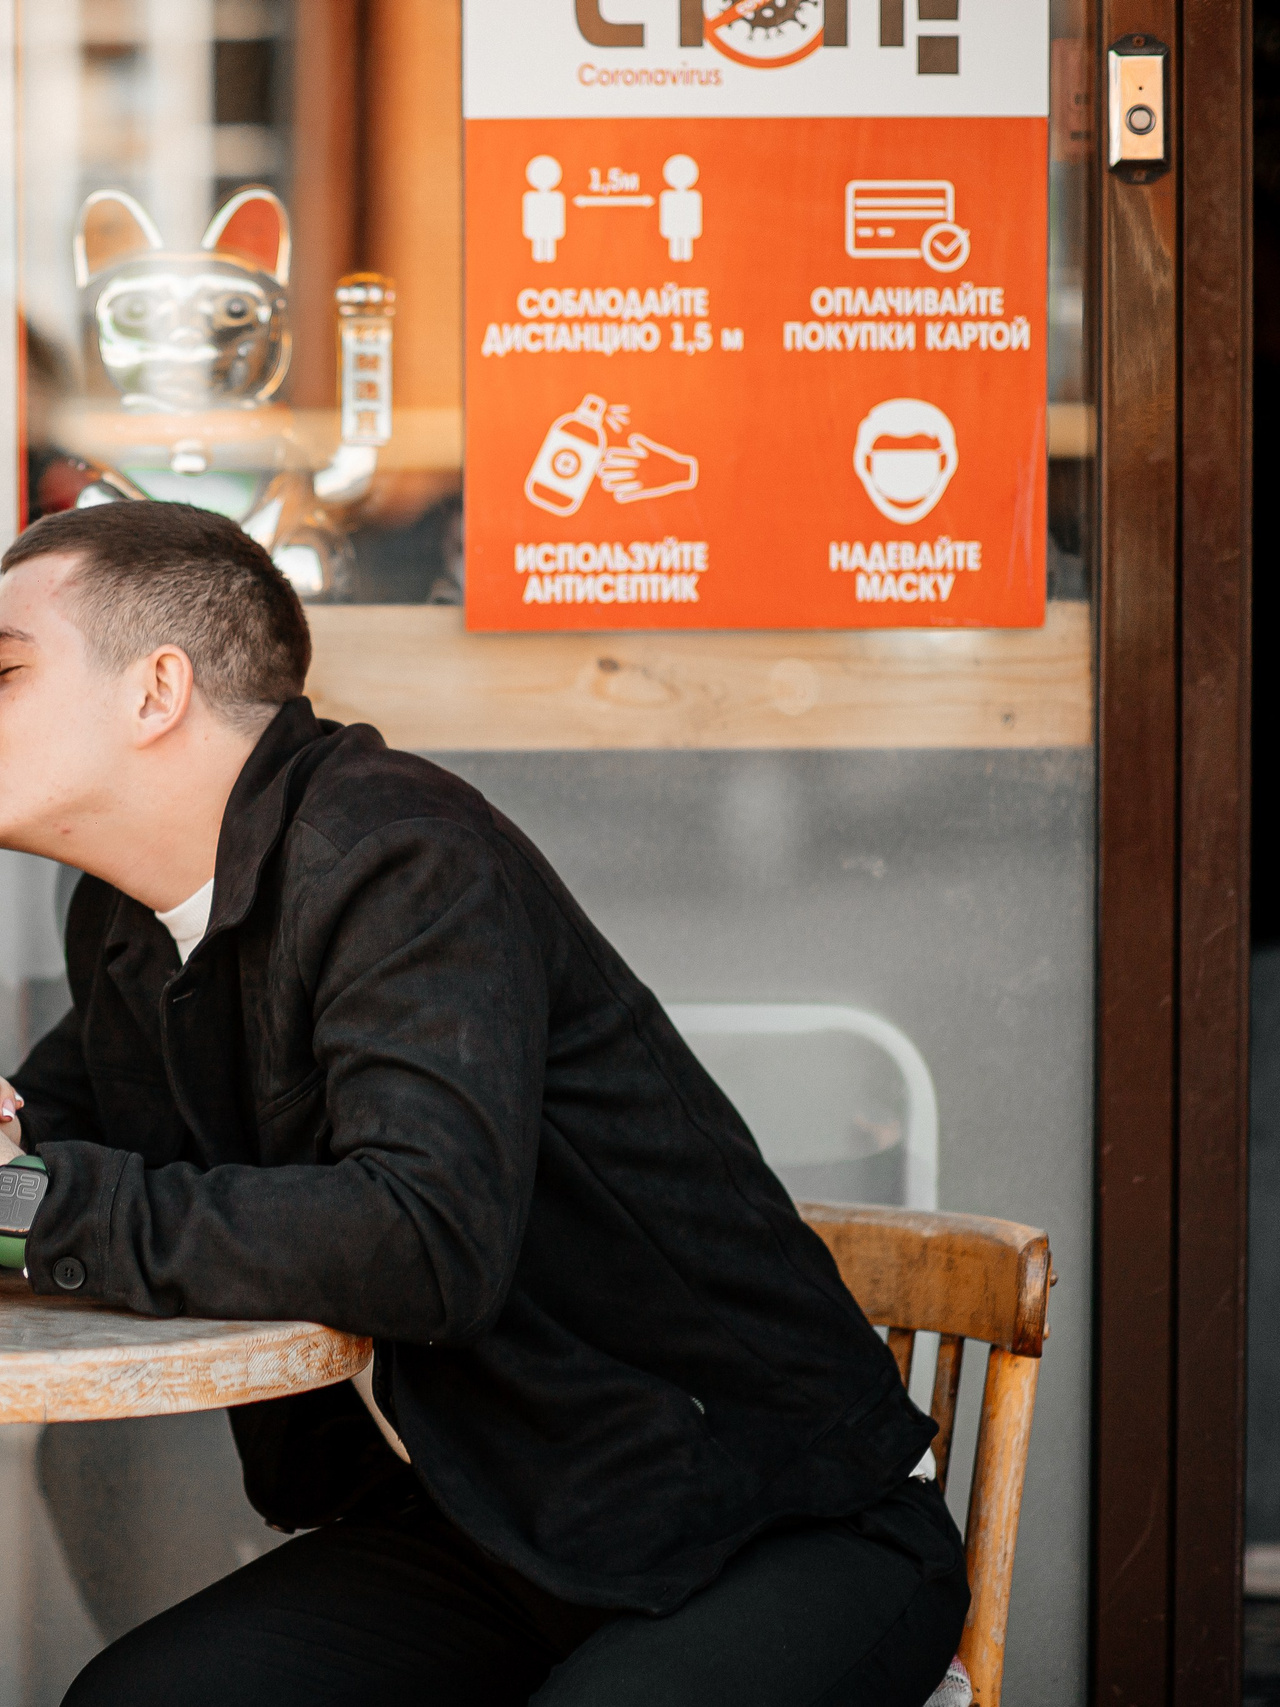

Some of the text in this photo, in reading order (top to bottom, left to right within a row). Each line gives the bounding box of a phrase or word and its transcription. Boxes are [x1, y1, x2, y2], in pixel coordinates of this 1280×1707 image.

[577, 63, 723, 87] Coronavirus
[517, 283, 708, 320] СОБЛЮДАЙТЕ
[811, 282, 1003, 317] ОПЛАЧИВАЙТЕ
[481, 322, 744, 357] ДИСТАНЦИЮ 1,5 м
[783, 316, 1031, 352] ПОКУПКИ КАРТОЙ
[514, 537, 708, 573] ИСПОЛЬЗУЙТЕ
[829, 537, 981, 572] НАДЕВАЙТЕ
[523, 573, 699, 604] АНТИСЕПТИК
[855, 573, 955, 602] МАСКУ
